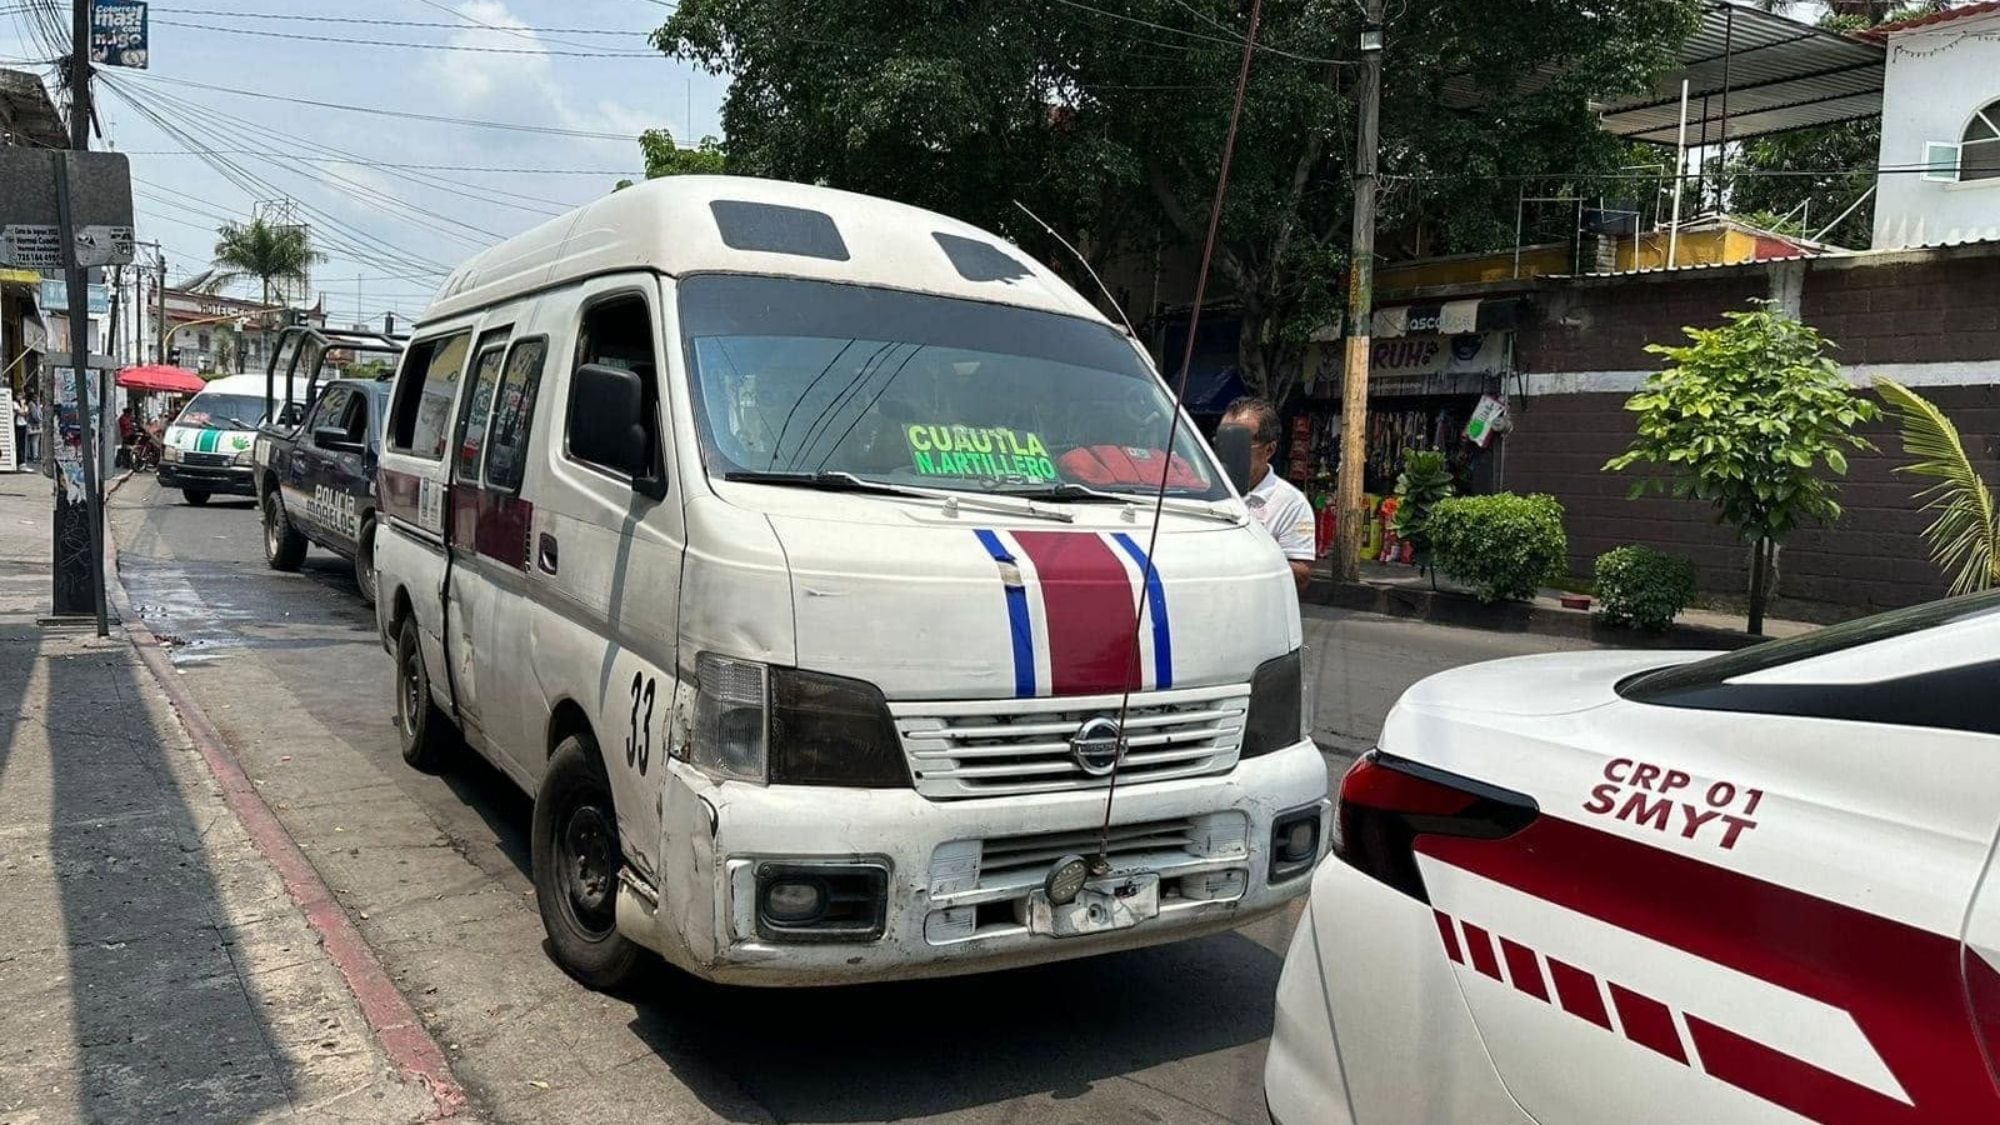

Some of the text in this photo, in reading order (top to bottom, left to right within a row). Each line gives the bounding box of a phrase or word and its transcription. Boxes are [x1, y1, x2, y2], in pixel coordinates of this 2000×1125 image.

[908, 425, 1048, 457] CUAUTLA
[914, 451, 1056, 479] N.ARTILLERO
[626, 671, 655, 776] 33
[1603, 757, 1764, 816] CRP 01
[1582, 783, 1758, 850] SMYT
